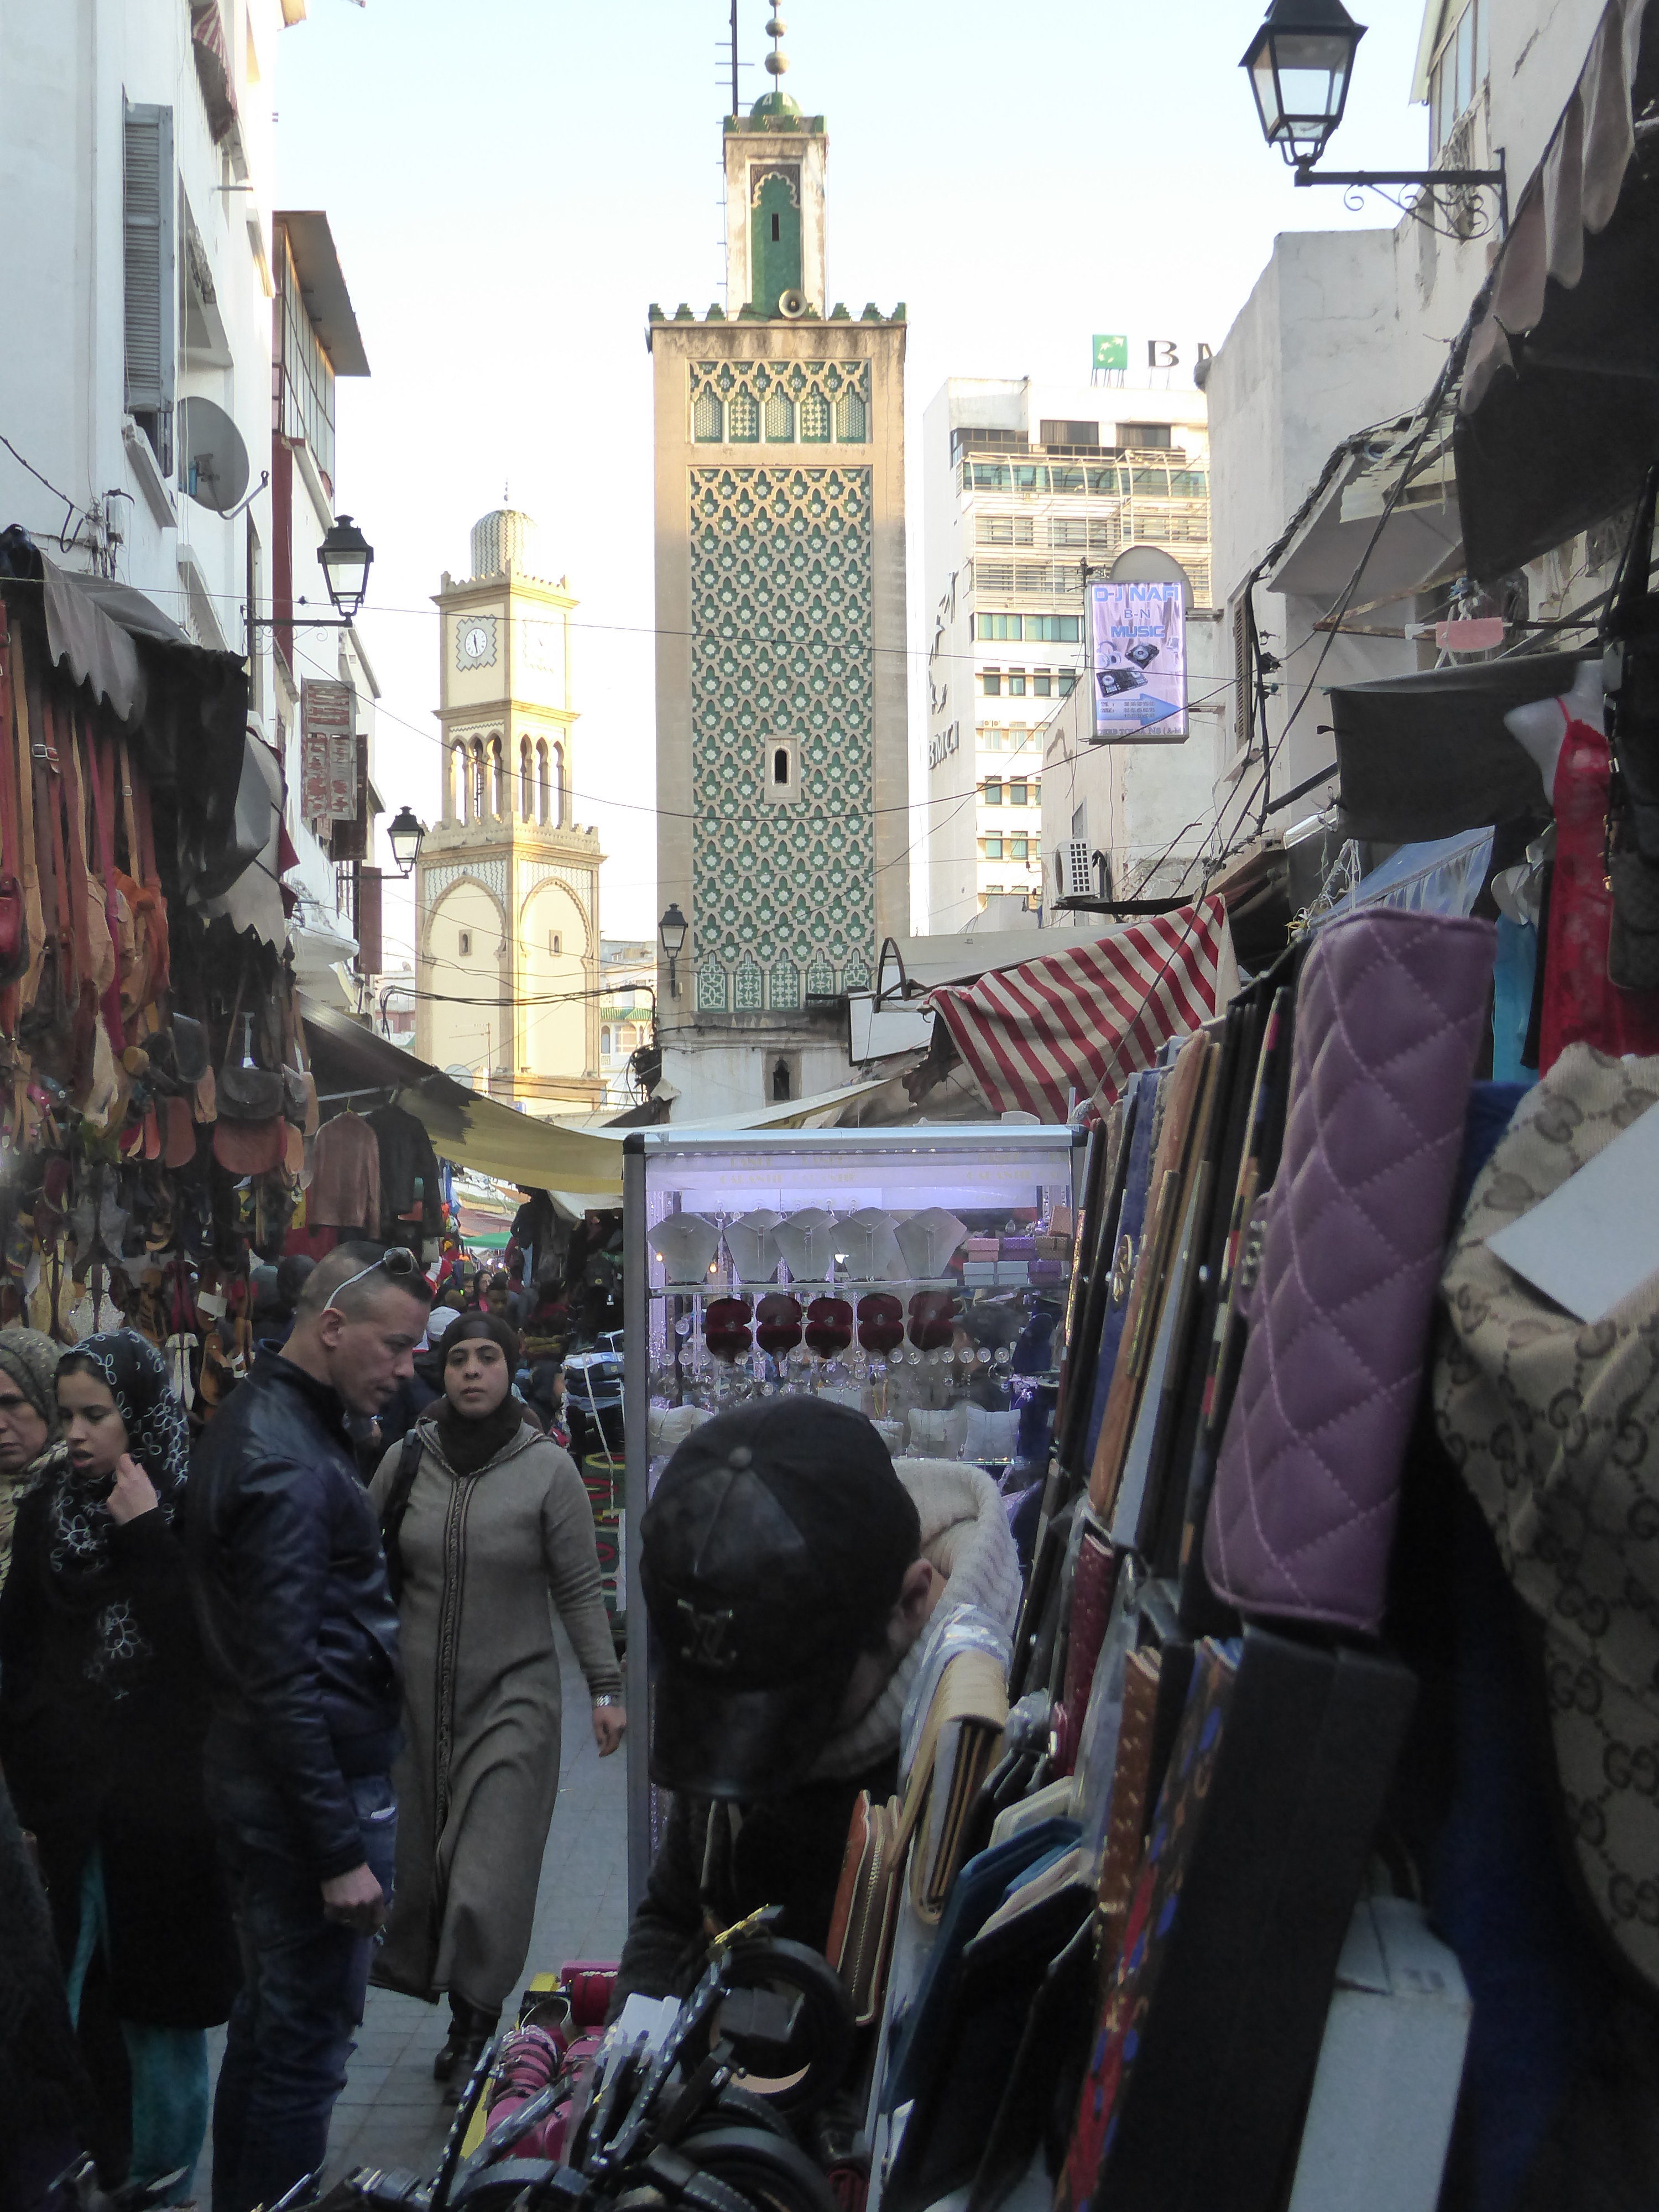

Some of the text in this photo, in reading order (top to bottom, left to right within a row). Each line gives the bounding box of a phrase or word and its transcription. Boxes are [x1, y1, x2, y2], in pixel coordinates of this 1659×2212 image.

[1124, 609, 1150, 619] B-N
[1110, 625, 1165, 638] MUSIC
[928, 720, 959, 770] BMCI
